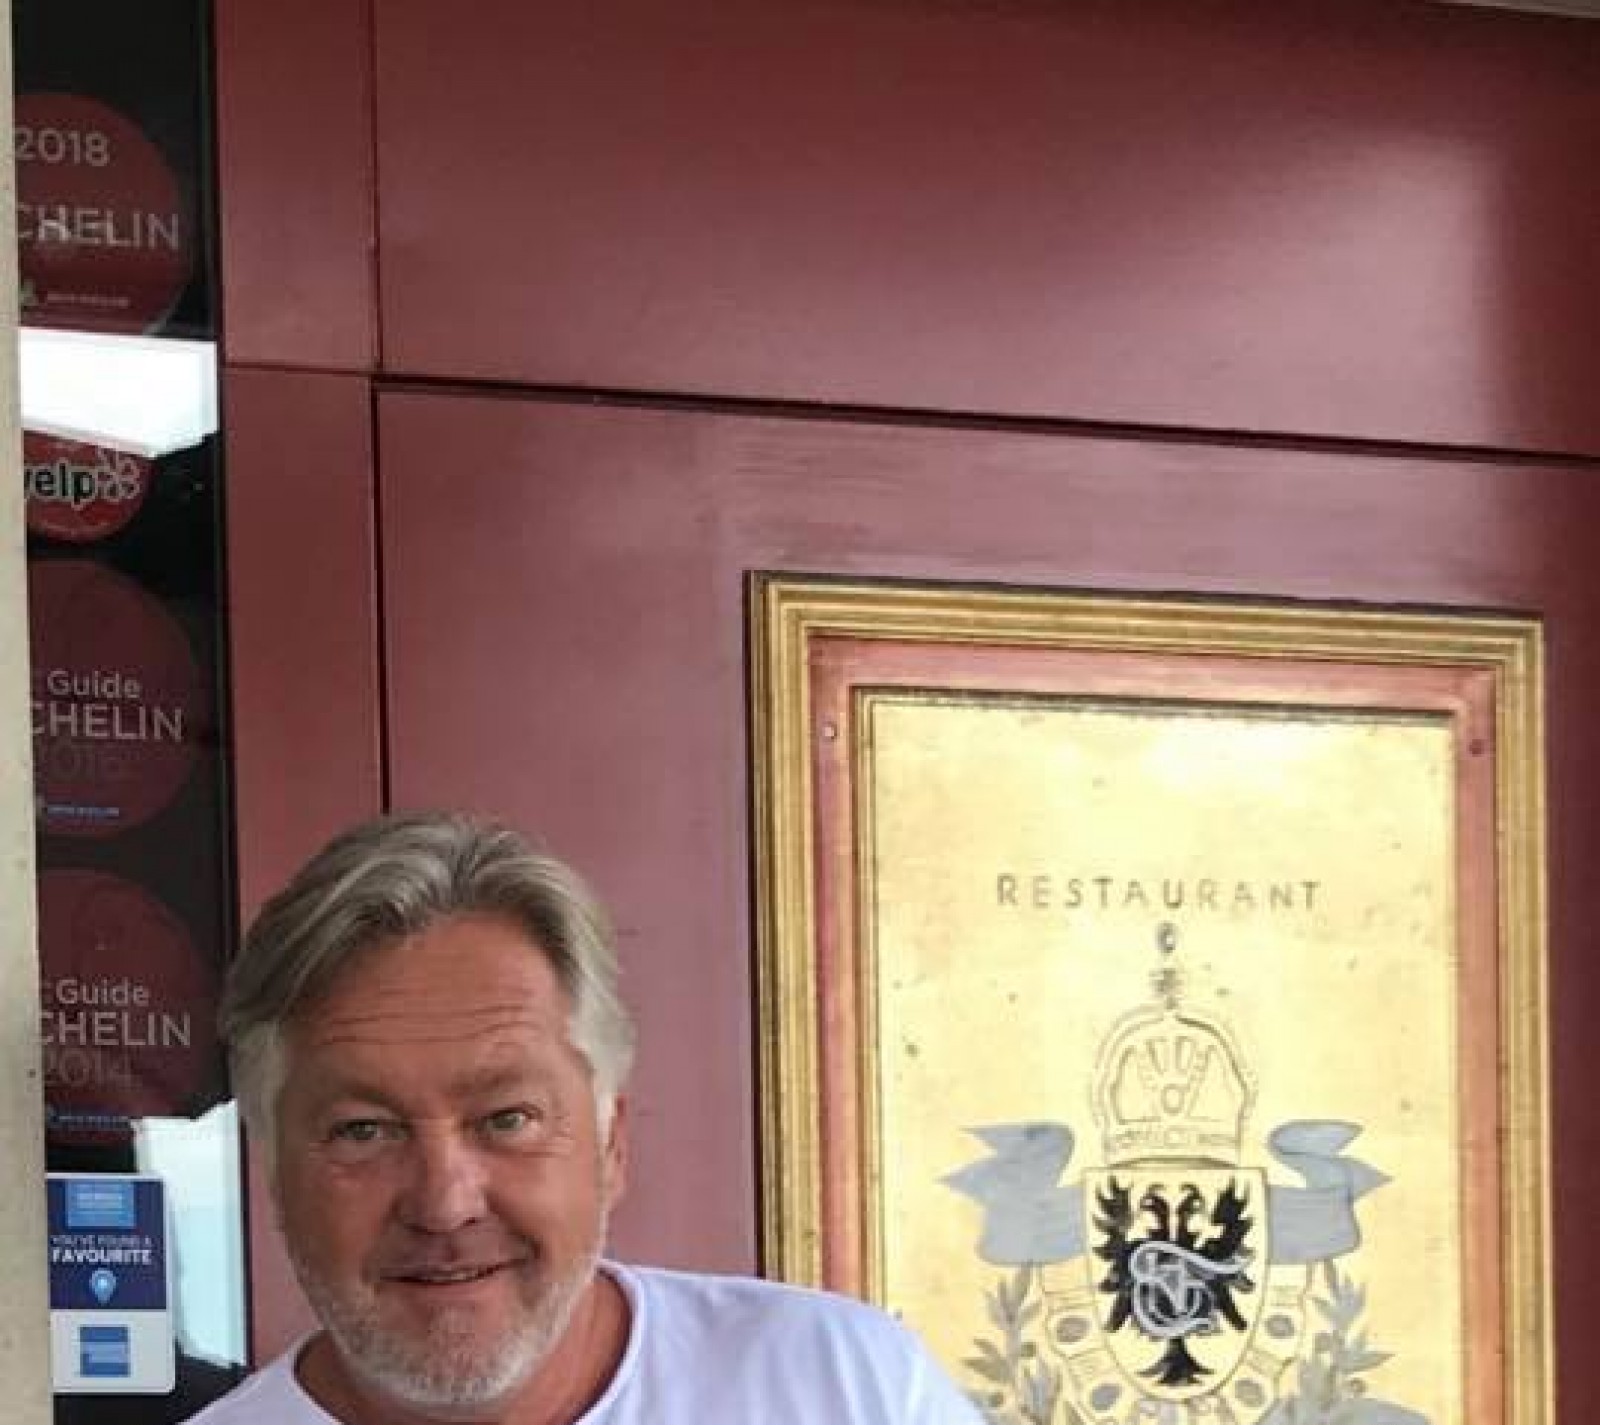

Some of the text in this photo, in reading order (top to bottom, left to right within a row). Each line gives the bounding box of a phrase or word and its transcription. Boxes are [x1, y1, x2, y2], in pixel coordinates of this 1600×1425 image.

[14, 126, 110, 168] 2018
[47, 671, 142, 698] Guide
[996, 873, 1323, 911] RESTAURANT
[56, 976, 149, 1007] Guide
[52, 1248, 153, 1265] FAVOURITE
